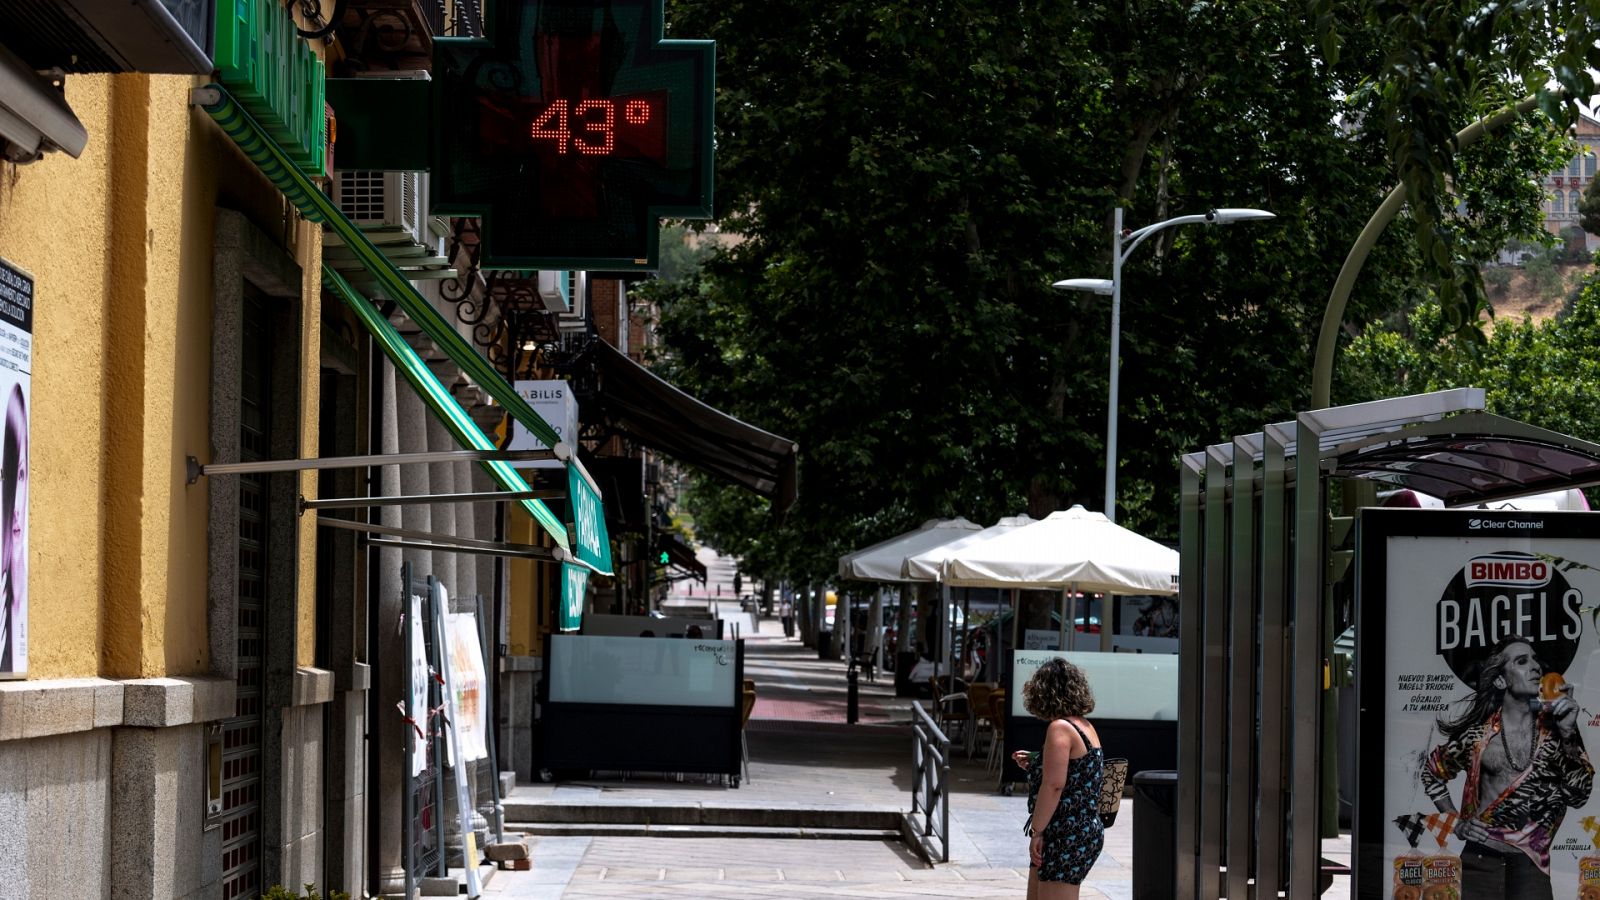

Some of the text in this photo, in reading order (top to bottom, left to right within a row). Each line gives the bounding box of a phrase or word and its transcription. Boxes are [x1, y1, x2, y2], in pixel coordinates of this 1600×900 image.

[1482, 519, 1544, 529] Clear Channel
[1471, 562, 1547, 580] BIMBO
[1439, 587, 1583, 650] BAGELS
[1397, 674, 1425, 683] NUEVOS
[1398, 682, 1455, 691] BAGELS BRIOCHE
[1410, 694, 1442, 703] GÓZALOS
[1402, 704, 1408, 712] A
[1419, 704, 1450, 712] MANERA
[1399, 867, 1422, 879] BAGEL
[1428, 866, 1456, 878] BAGELS
